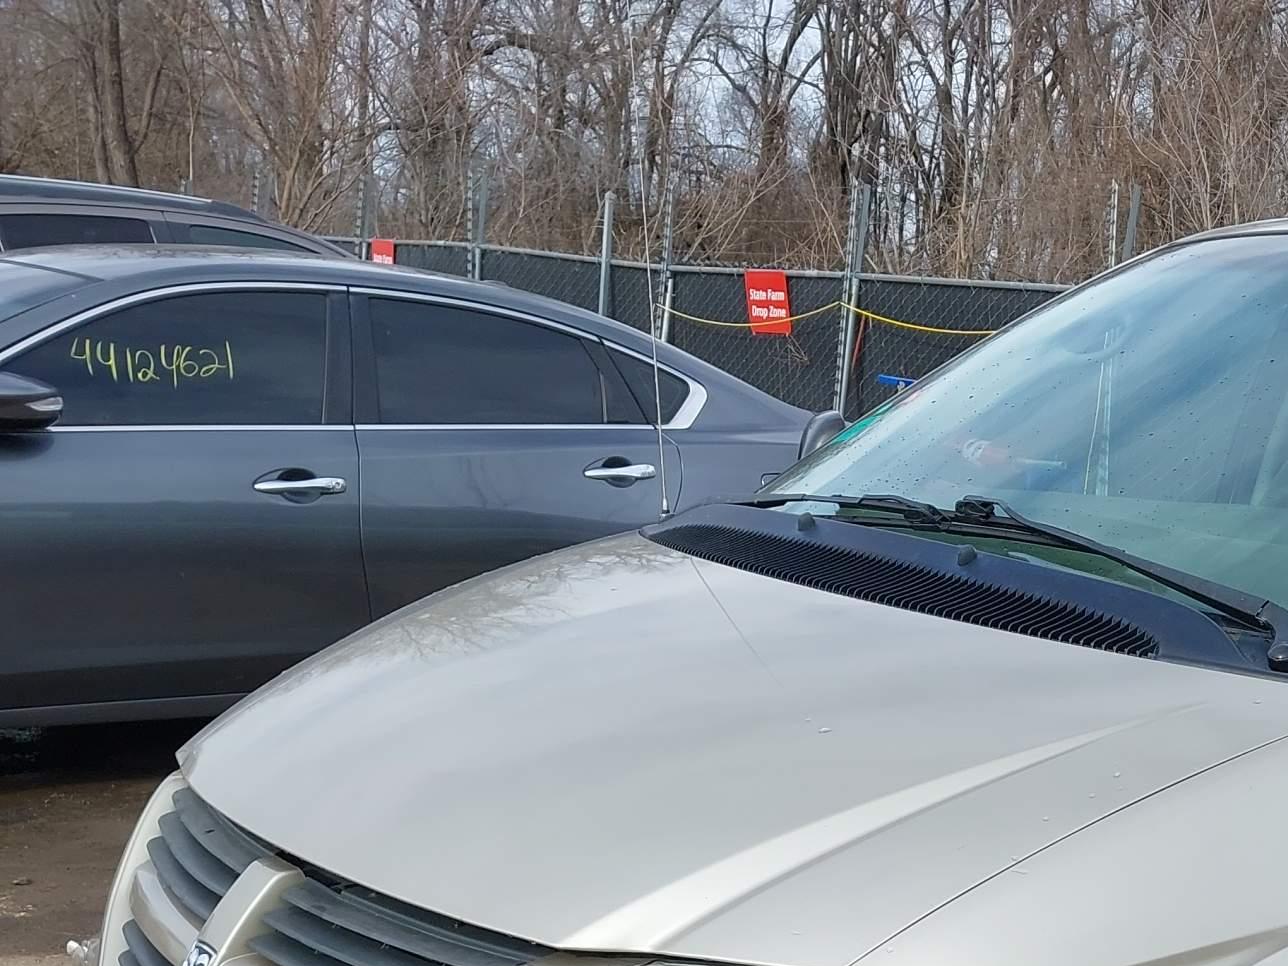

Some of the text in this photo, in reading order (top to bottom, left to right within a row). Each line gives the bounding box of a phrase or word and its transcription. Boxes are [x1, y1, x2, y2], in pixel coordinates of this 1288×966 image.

[750, 288, 785, 301] State Farm
[752, 305, 786, 319] Drop Zone
[70, 337, 234, 389] 44124621
